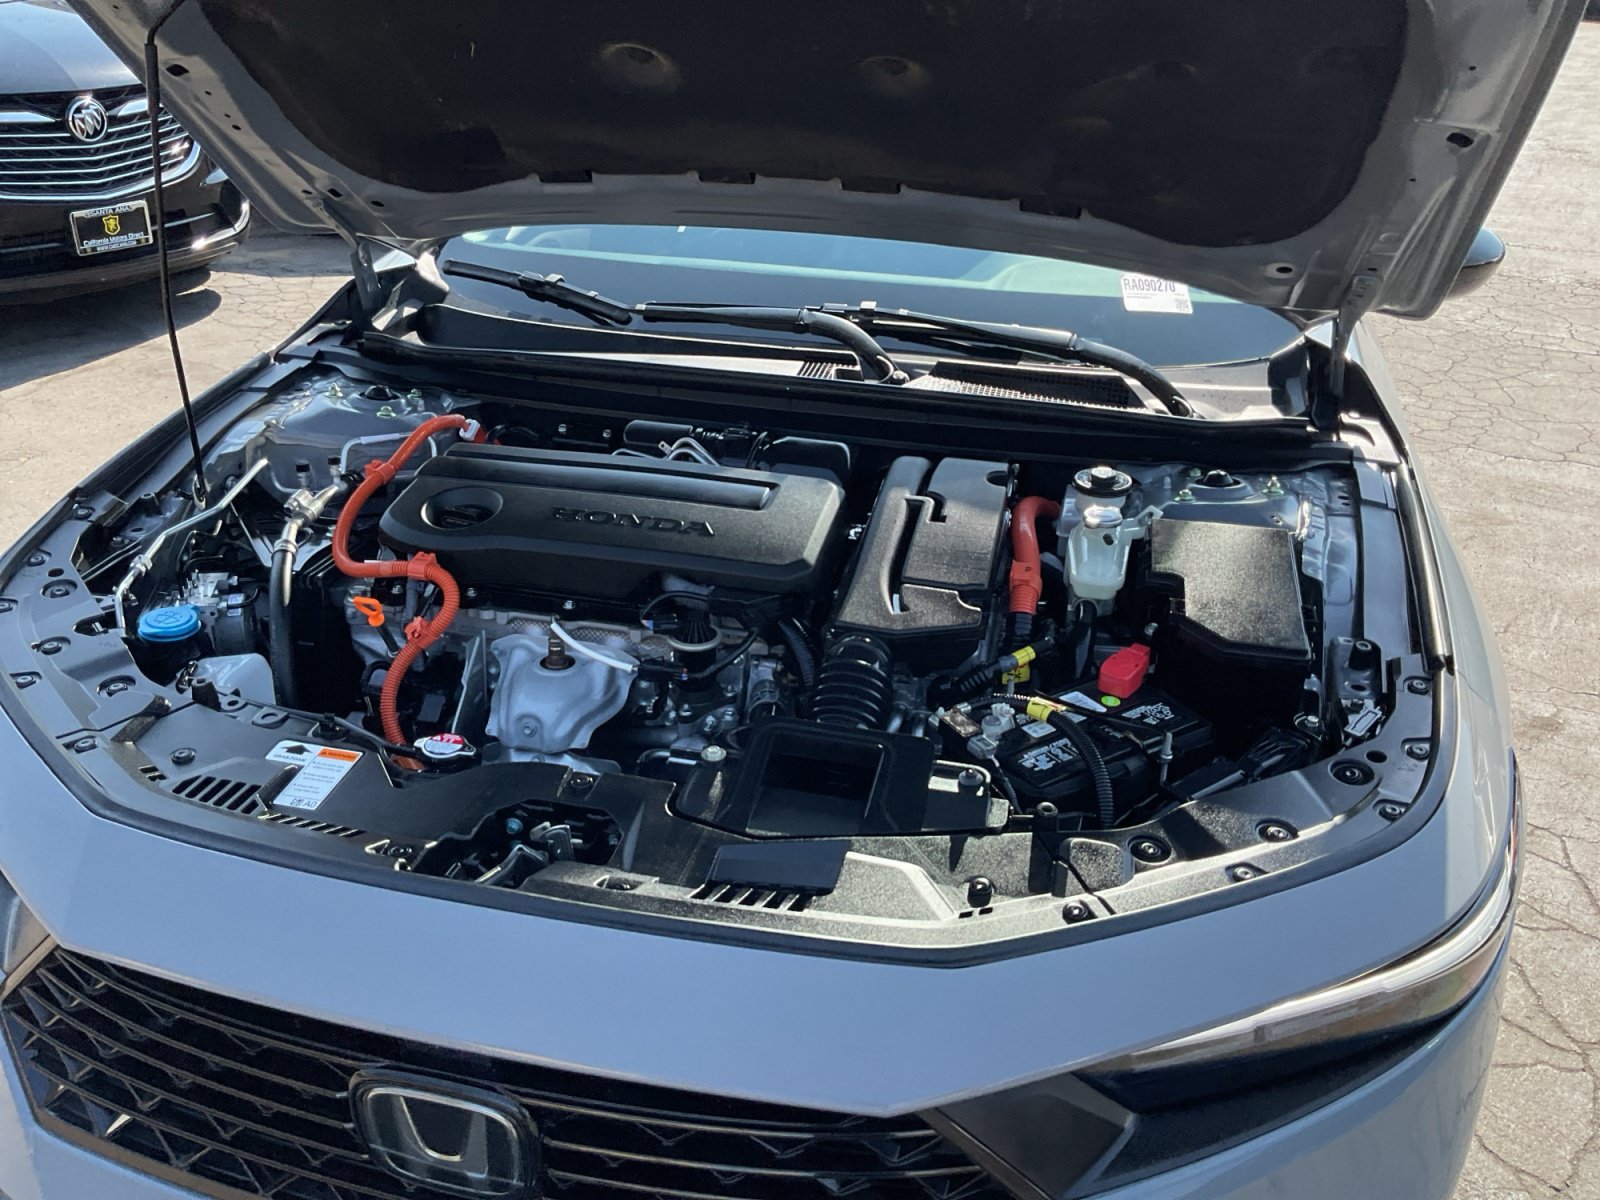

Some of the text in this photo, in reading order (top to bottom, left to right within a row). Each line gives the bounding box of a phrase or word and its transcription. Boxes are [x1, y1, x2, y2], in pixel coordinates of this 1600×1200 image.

[83, 237, 109, 247] California
[128, 231, 144, 240] Direct
[552, 507, 716, 537] HONDA
